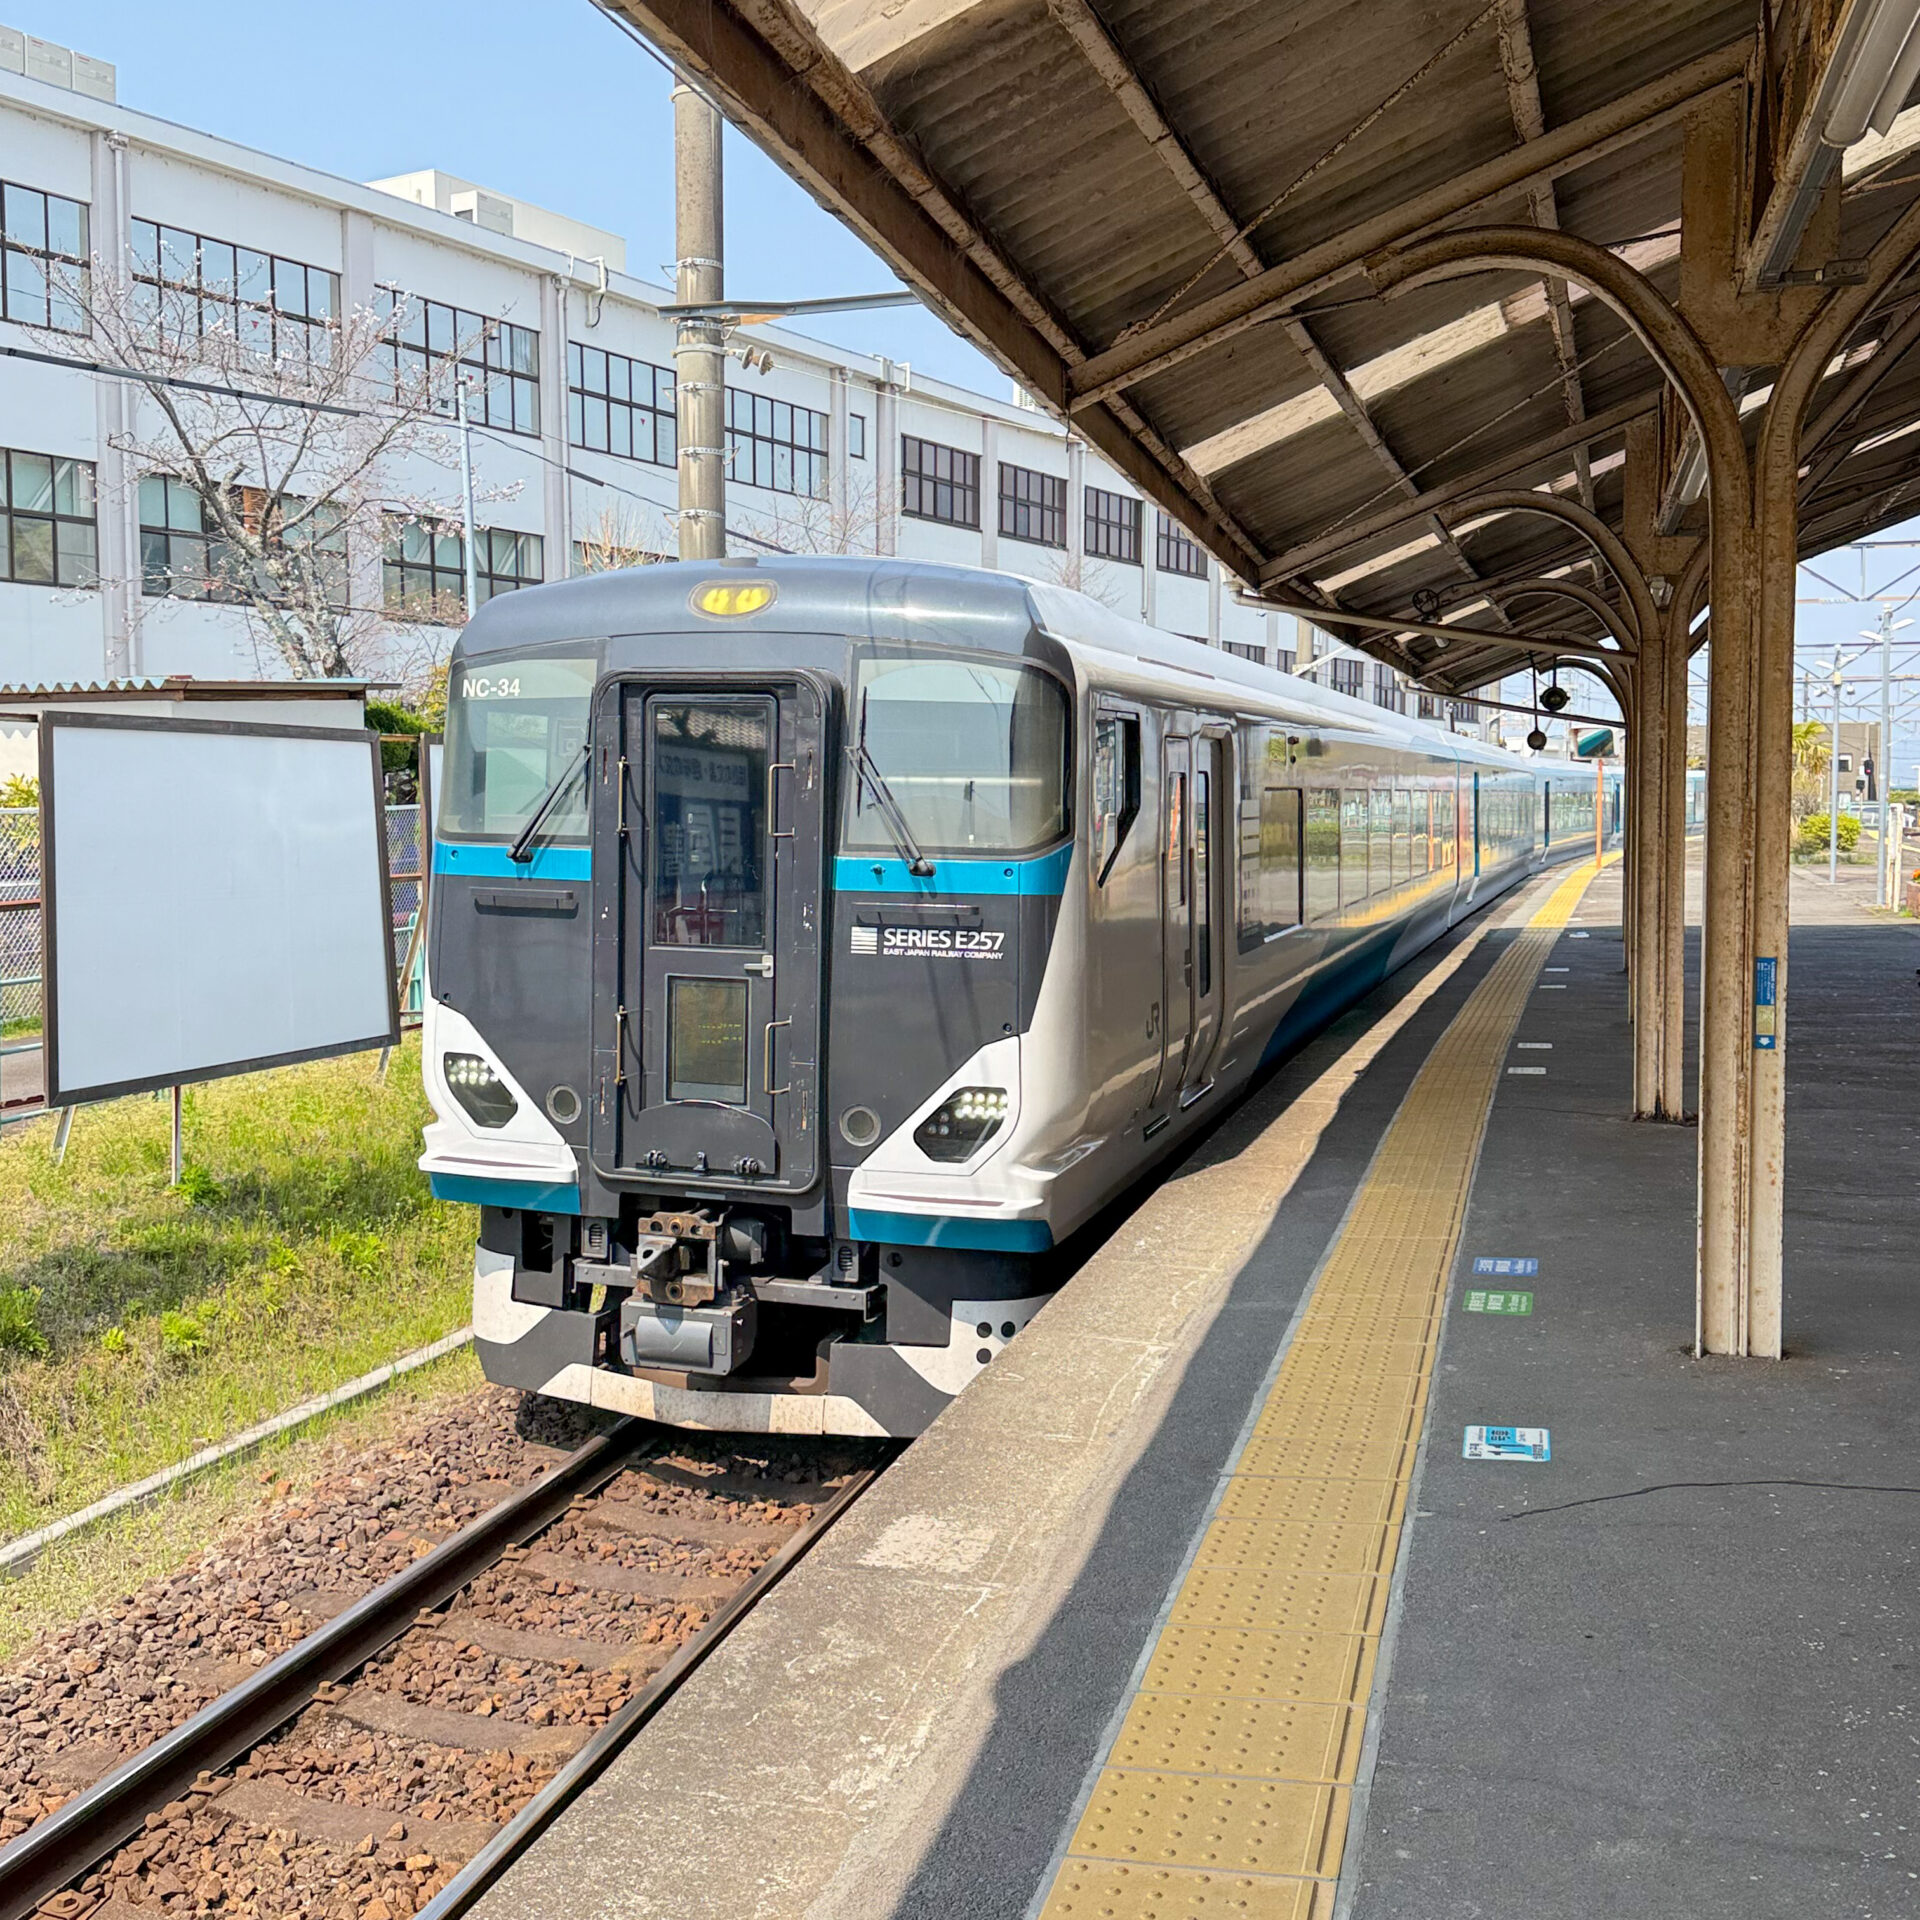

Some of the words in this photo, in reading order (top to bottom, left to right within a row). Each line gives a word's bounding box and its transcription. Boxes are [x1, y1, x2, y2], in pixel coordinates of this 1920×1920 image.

[462, 678, 521, 698] NC-34
[883, 928, 951, 949] SERIES
[955, 931, 1005, 951] E257
[883, 948, 904, 956] EAST
[904, 949, 930, 957] JAPAN
[931, 950, 963, 959] RAILWAY
[964, 951, 1004, 960] COMPANY
